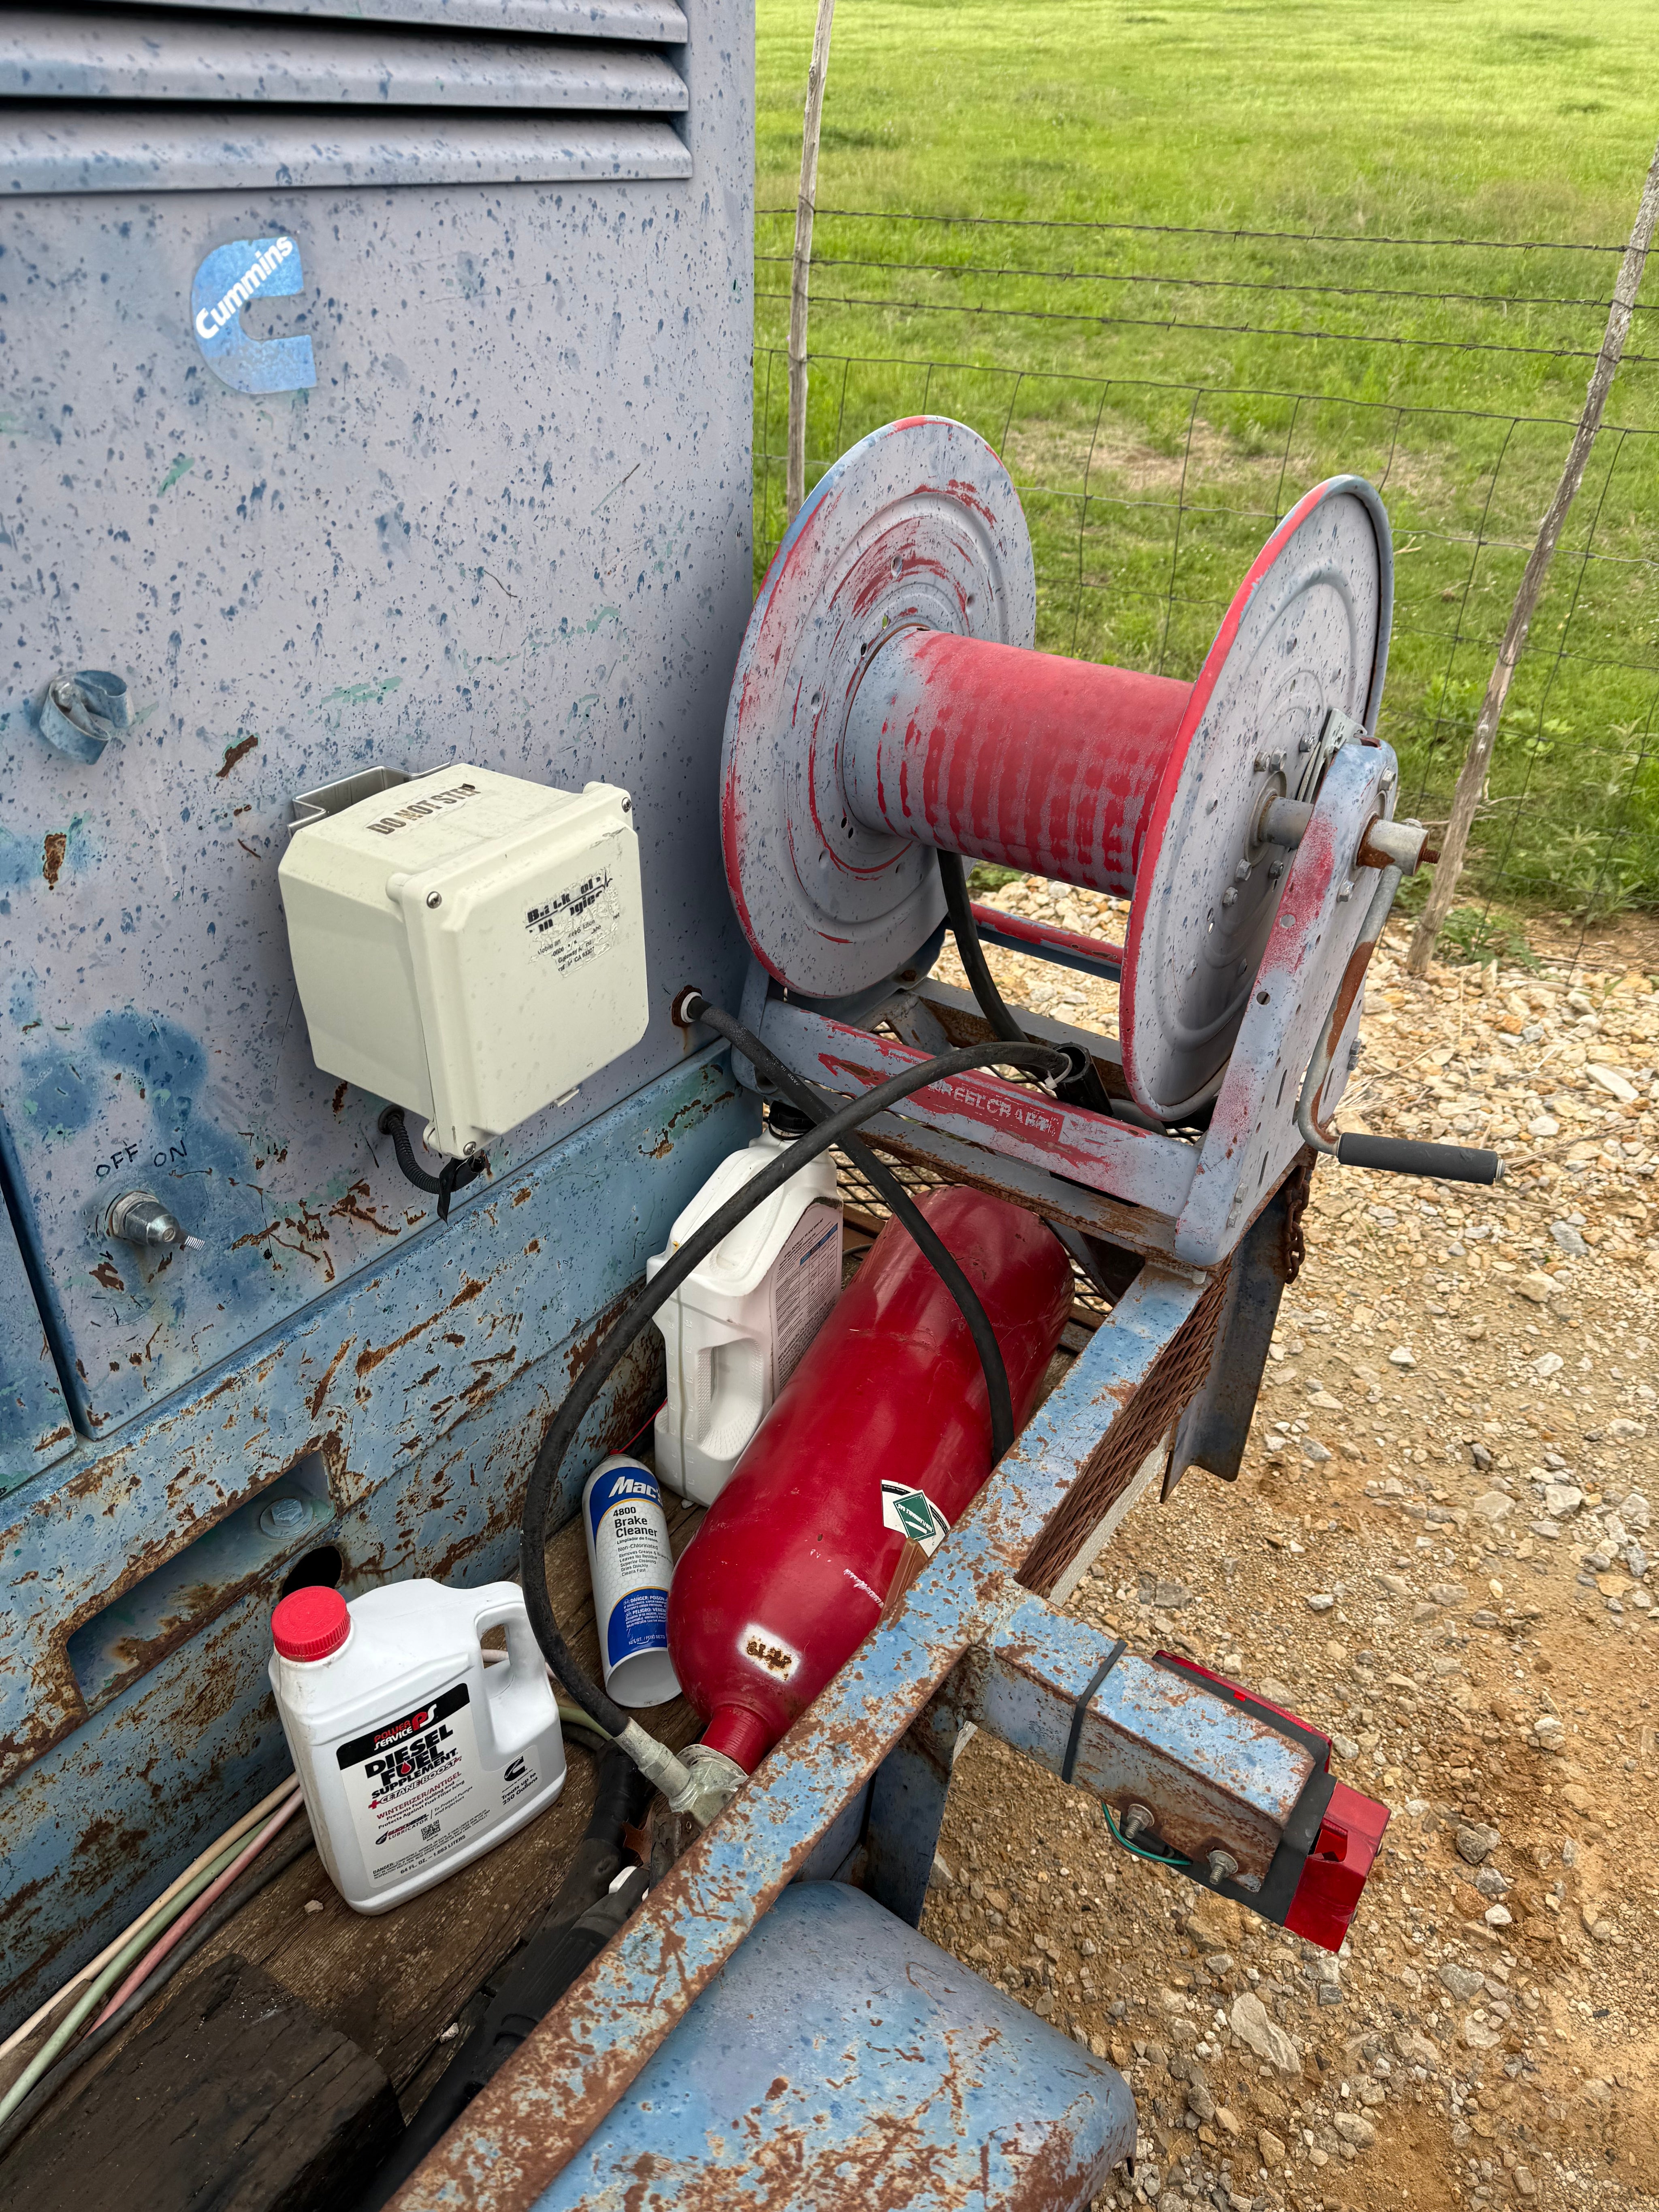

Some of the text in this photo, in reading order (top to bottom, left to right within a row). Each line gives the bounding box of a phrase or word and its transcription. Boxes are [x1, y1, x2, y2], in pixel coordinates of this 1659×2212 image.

[196, 236, 293, 339] Cummins
[365, 817, 407, 835] DO
[394, 800, 443, 821] NOT
[96, 1140, 187, 1177] OFF ON
[613, 1506, 636, 1517] 4800
[898, 1503, 906, 1512] GAS
[614, 1516, 648, 1529] Brake
[616, 1527, 658, 1538] Cleaner
[374, 1720, 411, 1743] POWER
[374, 1726, 413, 1751] SERVICE
[365, 1724, 454, 1779] DIESEL
[371, 1747, 458, 1799] SUPPLEMENT
[381, 1745, 444, 1787] FUEL
[376, 1771, 462, 1820] WINTERIZER/ANTIGEL
[386, 1781, 455, 1821] Prevents Fuel Gelling and
[440, 1796, 457, 1809] Protect
[501, 1785, 520, 1800] Treats
[502, 1777, 538, 1806] 250 Gallons
[378, 1780, 465, 1830] Protects Against Fuel-Filter Icing
[435, 1807, 444, 1816] and
[388, 1817, 428, 1840] LUBRICATOR
[448, 1834, 466, 1848] LITERS
